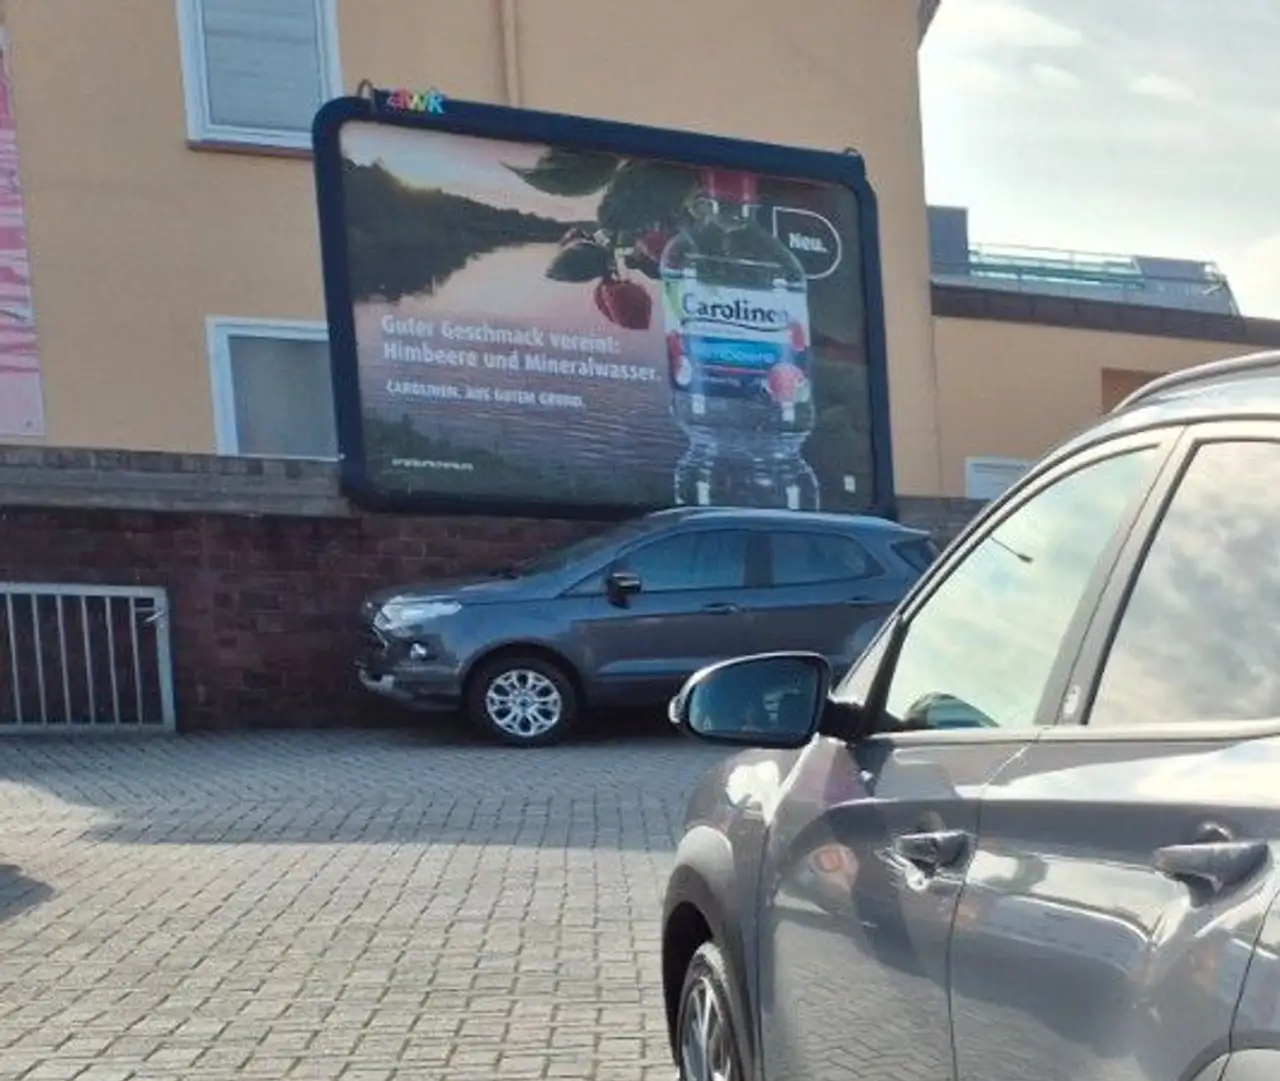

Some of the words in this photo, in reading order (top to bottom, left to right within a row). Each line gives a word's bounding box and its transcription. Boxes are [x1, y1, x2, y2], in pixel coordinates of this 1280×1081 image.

[382, 314, 434, 337] Guter
[442, 320, 544, 347] Geschmack
[384, 340, 478, 368] Himbeere
[484, 350, 519, 372] und
[525, 353, 661, 382] Mineralwasser.
